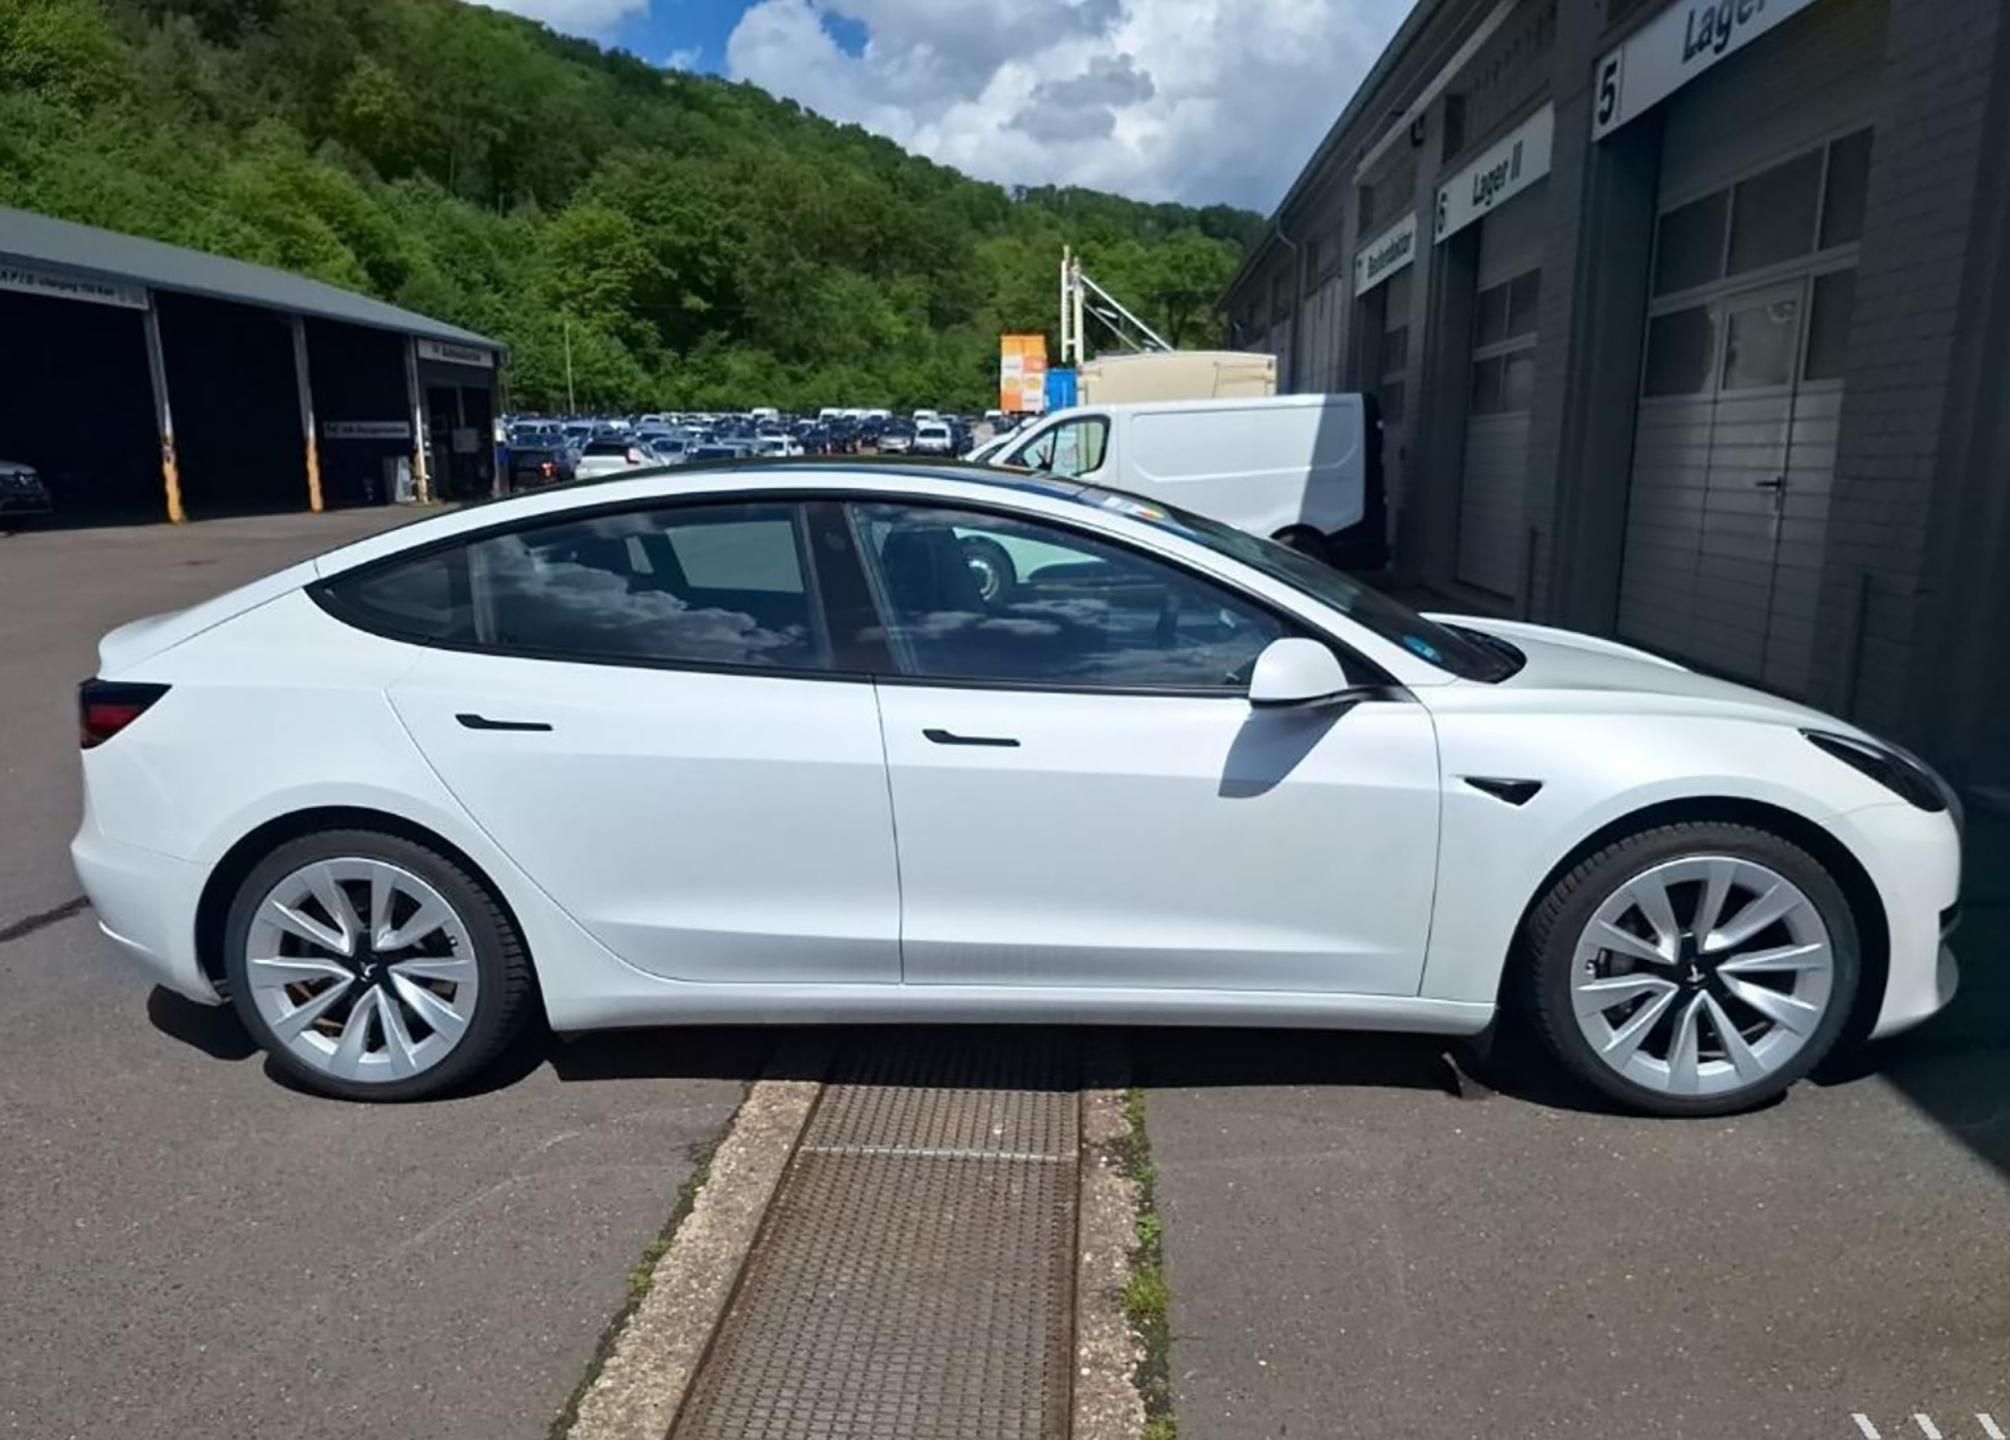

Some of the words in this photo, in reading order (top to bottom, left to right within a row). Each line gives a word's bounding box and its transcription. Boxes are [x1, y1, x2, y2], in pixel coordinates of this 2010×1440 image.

[1598, 61, 1617, 125] 5
[1472, 158, 1509, 207] Lager
[1437, 192, 1447, 234] 6
